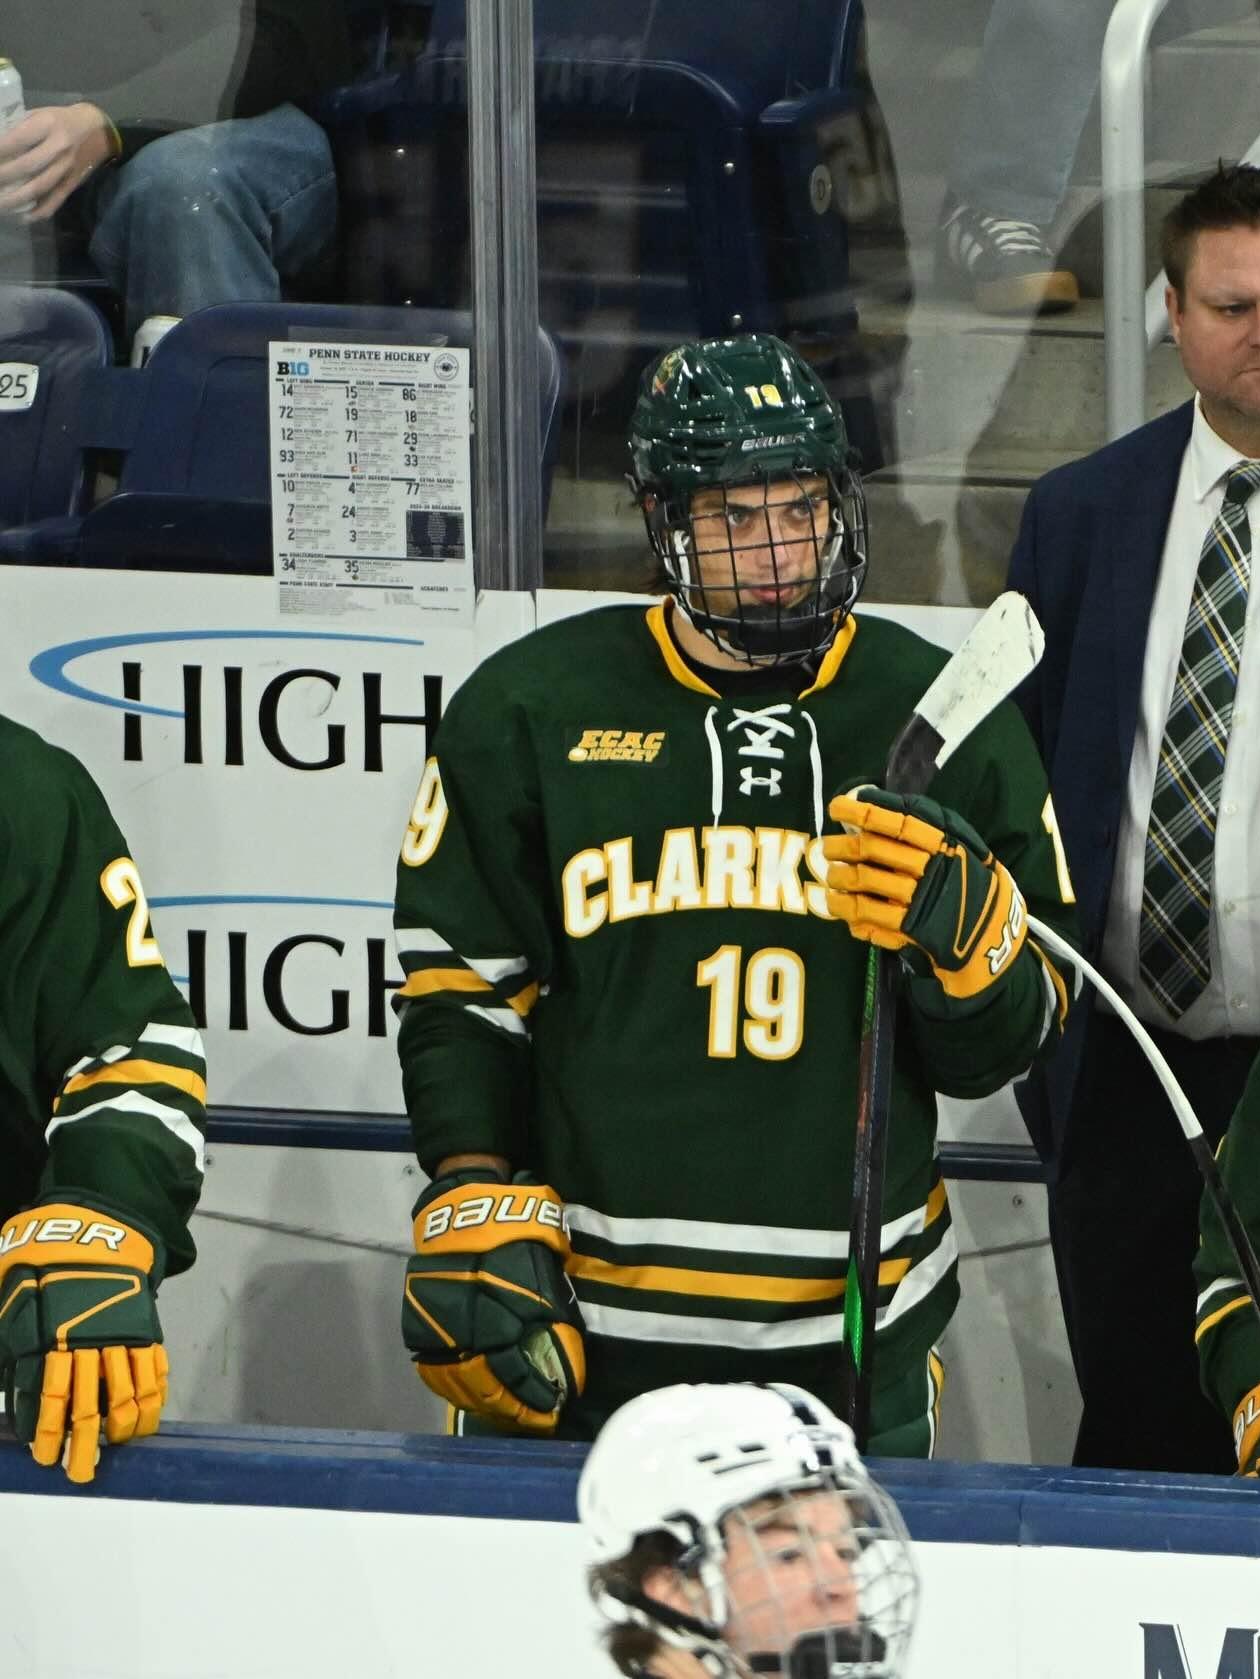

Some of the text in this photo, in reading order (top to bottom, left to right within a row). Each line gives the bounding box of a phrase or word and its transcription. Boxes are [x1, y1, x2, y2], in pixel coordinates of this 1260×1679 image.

[309, 348, 341, 359] PENN
[344, 350, 381, 361] STATE
[385, 351, 431, 362] HOCKEY
[281, 383, 294, 397] 14
[345, 386, 358, 399] 15
[744, 383, 784, 409] 19
[279, 406, 294, 419] 72
[345, 408, 359, 421] 19
[281, 428, 294, 441] 12
[345, 430, 358, 443] 71
[348, 452, 358, 465] 11
[404, 454, 418, 467] 33
[282, 480, 295, 493] 10
[348, 482, 356, 494] 4
[406, 482, 420, 495] 77
[287, 503, 295, 517] 7
[342, 505, 356, 518] 24
[287, 528, 295, 541] 2
[349, 530, 357, 542] 3
[282, 558, 296, 571] 34
[344, 560, 359, 573] 35
[122, 661, 443, 772] HIGH
[577, 730, 665, 750] ECAC
[587, 747, 659, 763] HOCKEY
[99, 856, 166, 968] 2
[697, 945, 806, 1061] 19
[423, 1194, 571, 1243] BAUE
